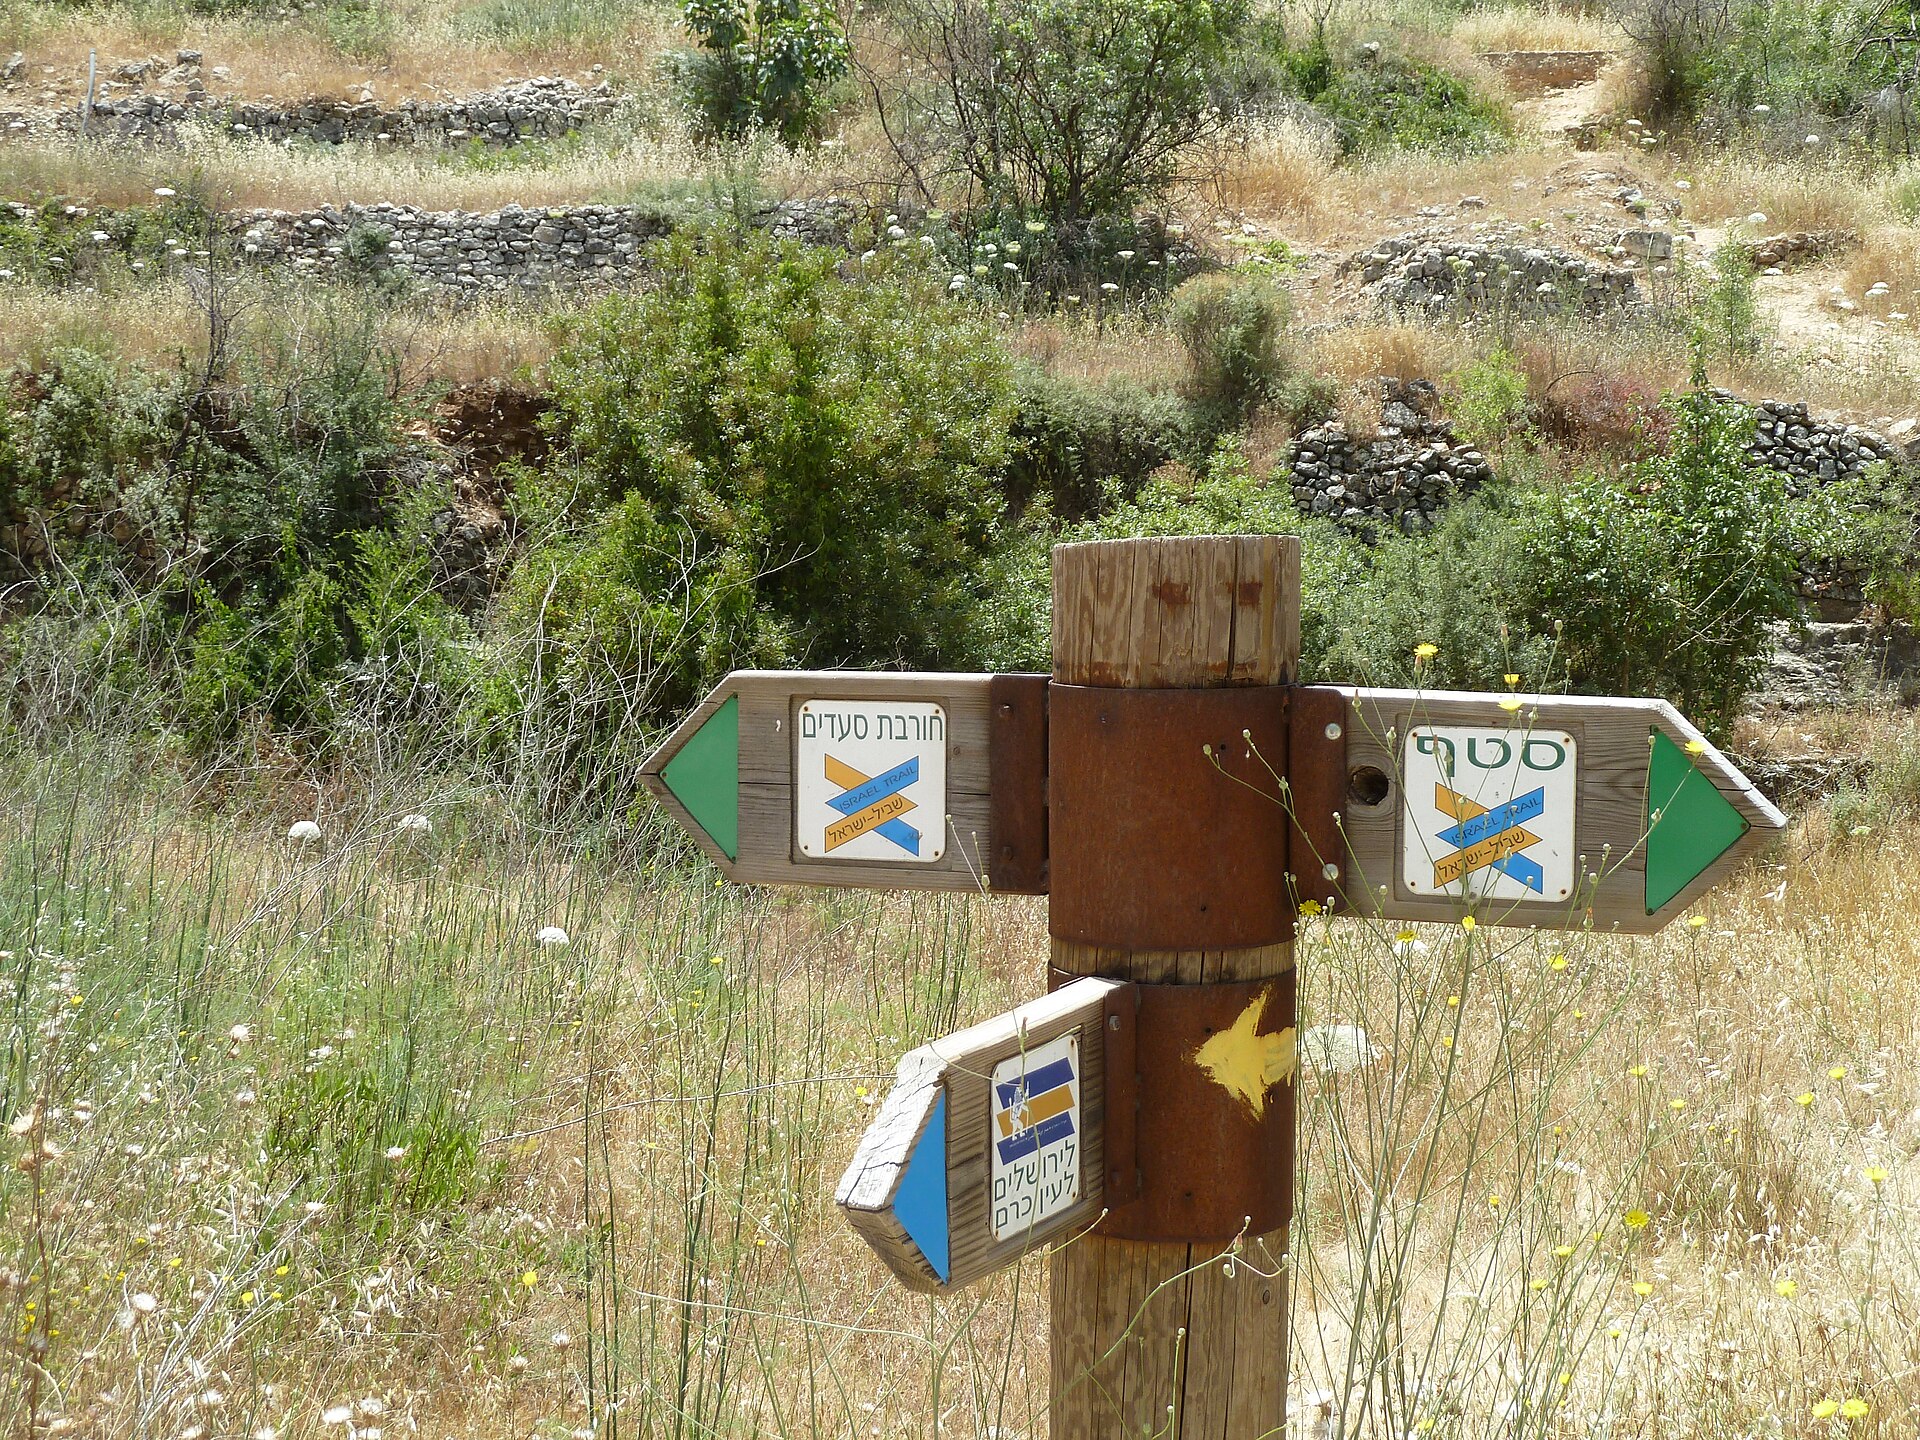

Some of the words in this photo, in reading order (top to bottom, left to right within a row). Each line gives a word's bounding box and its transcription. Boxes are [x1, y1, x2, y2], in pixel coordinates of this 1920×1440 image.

[802, 712, 869, 743] סעדים
[876, 714, 943, 741] חורבת
[1416, 735, 1566, 778] סטף
[839, 785, 880, 811] ISRAEL
[884, 766, 917, 788] TRAIL
[1451, 817, 1499, 844] ISRAEL
[1504, 797, 1542, 820] TRAIL
[994, 1139, 1076, 1202] לירושלים
[1040, 1170, 1075, 1214] לעין
[995, 1195, 1033, 1229] כרם
